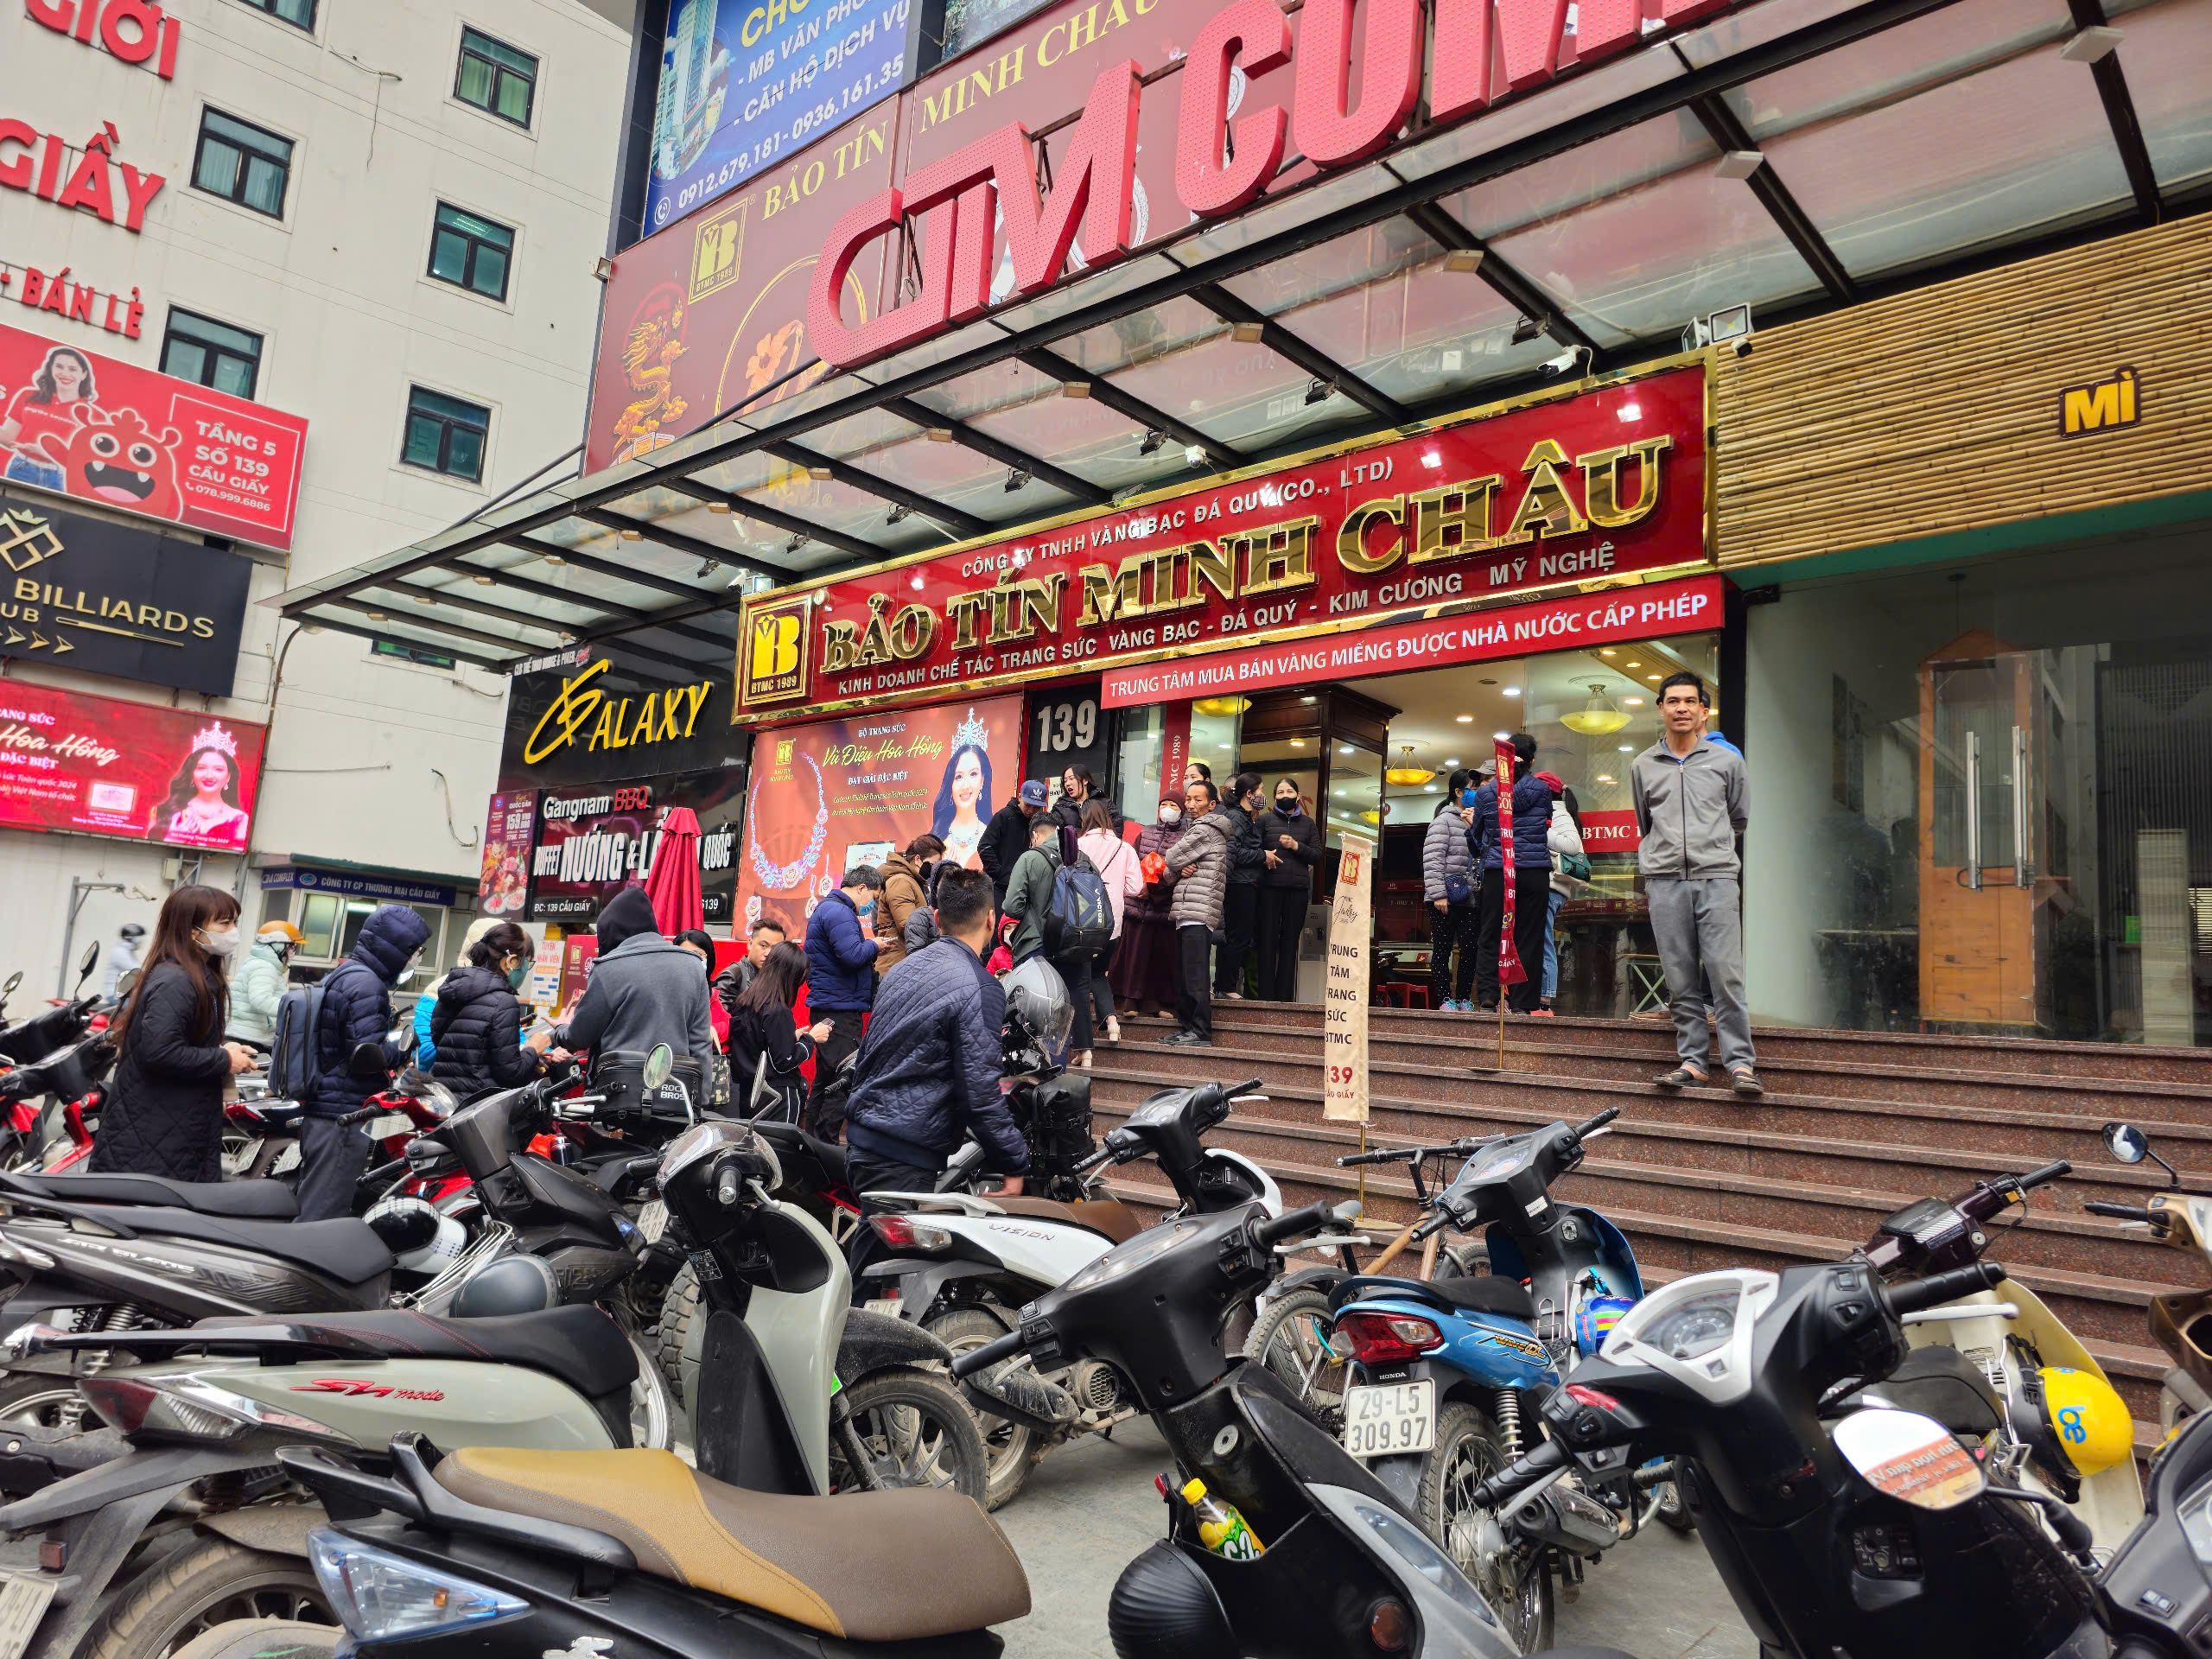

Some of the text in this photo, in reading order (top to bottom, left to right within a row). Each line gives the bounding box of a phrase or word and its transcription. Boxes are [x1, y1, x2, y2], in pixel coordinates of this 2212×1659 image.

[744, 0, 911, 122] CĂN HỘ DỊCH VỤ
[748, 16, 821, 83] MB VĂN
[791, 53, 904, 140] 0936.161.35
[762, 43, 1028, 221] BẢO TÍN MINH
[696, 266, 733, 292] BTMC 1989
[22, 266, 144, 339] BÁN LẺ
[2065, 370, 2136, 433] Mì
[195, 420, 276, 456] TẦNG 5
[194, 444, 270, 477] SỐ 139
[188, 463, 270, 496] CẦU GIẤY
[195, 484, 271, 512] 078.999.6886
[962, 553, 1009, 578] CÔNG
[1016, 548, 1035, 569] TY
[1039, 534, 1087, 560] TNHH
[1090, 518, 1141, 546] VÀNG
[1147, 510, 1185, 536] BẠC
[1193, 497, 1222, 524] ĐÁ
[1340, 455, 1394, 489] LTD)
[819, 434, 1675, 675] BẢO TÍN MINH CHÂU
[14, 578, 215, 639] BILLIARDS
[838, 541, 1616, 696] KINH DOANH CHẾ TÁC TRANG SỨC VÀNG BẠC ĐÁ QUÝ KIM CƯƠNG MỸ NGHỆ
[1109, 592, 1708, 697] TRUNG TÂM MUA BÁN VÀNG MIẾNG ĐƯỢC NHÀ NƯỚC CẤP PHÉP
[751, 676, 797, 694] BTMC 1989
[28, 712, 55, 725] SỨC
[524, 658, 710, 765] GALAXY
[1038, 699, 1096, 752] 139
[868, 726, 890, 736] TRANG
[1172, 734, 1181, 760] 1989
[29, 756, 59, 769] BIỆT
[51, 734, 120, 766] Hồng
[822, 734, 944, 767] Vũ Điệu Hoa Hồng
[58, 780, 77, 789] 2024
[543, 785, 649, 822] Gangnam BBQ
[1582, 825, 1630, 840] BTMC
[534, 845, 562, 876] BUFFET
[560, 823, 626, 882] NƯỚNG
[626, 840, 639, 870] &
[321, 876, 341, 887] CÔNG
[344, 880, 352, 889] TY
[353, 881, 363, 890] CP
[365, 882, 392, 893] THƯƠNG
[394, 887, 408, 897] MẠI
[534, 899, 591, 912] ĐC: 139 CẦU GIẤY
[1331, 965, 1350, 979] TÂM
[1327, 1009, 1347, 1022] SỨC
[661, 1084, 683, 1093] ROC
[1326, 1065, 1353, 1084] 39
[660, 1090, 685, 1100] BROS
[1337, 1089, 1355, 1099] GIẤY
[988, 1222, 1055, 1242] VISION
[1379, 1371, 1407, 1380] HONDA
[394, 1389, 445, 1402] mode
[1359, 1384, 1420, 1420] 29-L5
[1351, 1416, 1427, 1452] 309.97
[2057, 1404, 2087, 1445] be
